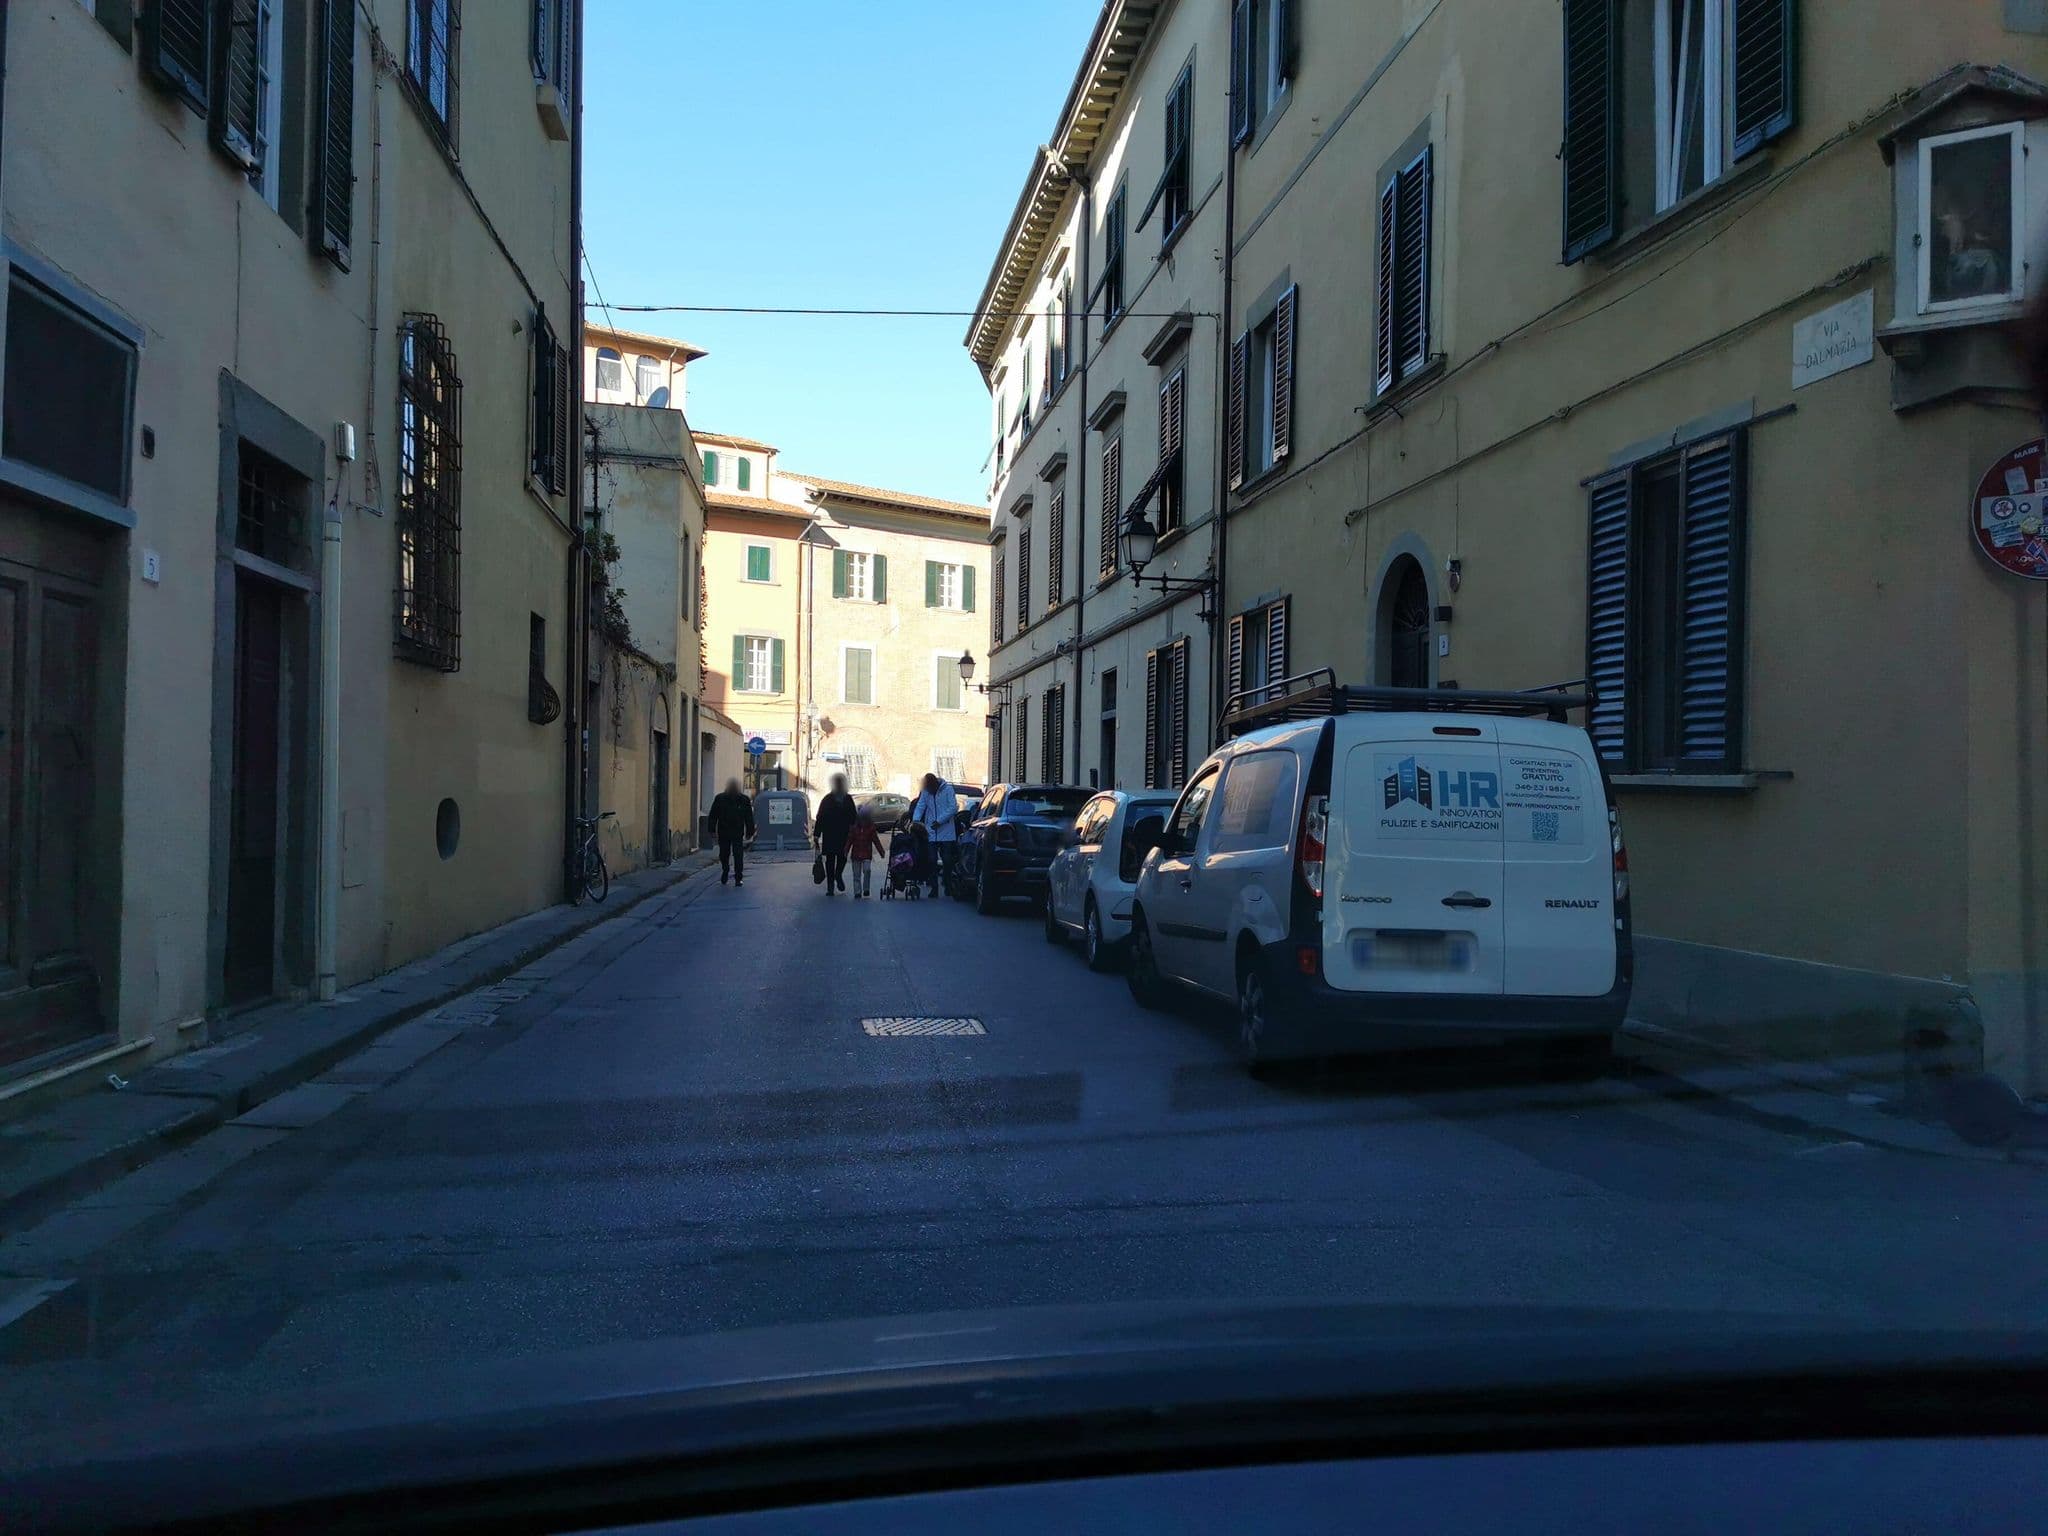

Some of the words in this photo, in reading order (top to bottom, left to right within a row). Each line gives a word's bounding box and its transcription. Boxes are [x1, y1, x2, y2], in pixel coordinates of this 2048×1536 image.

[1823, 321, 1840, 337] VIA
[1521, 773, 1564, 782] GRATUITO
[1438, 771, 1501, 808] HR
[1439, 809, 1502, 819] INNOVATION
[1380, 819, 1418, 828] PULIZIE
[1420, 820, 1428, 828] E
[1430, 820, 1499, 831] SANIFICAZIONI
[1544, 899, 1600, 909] RENAULT
